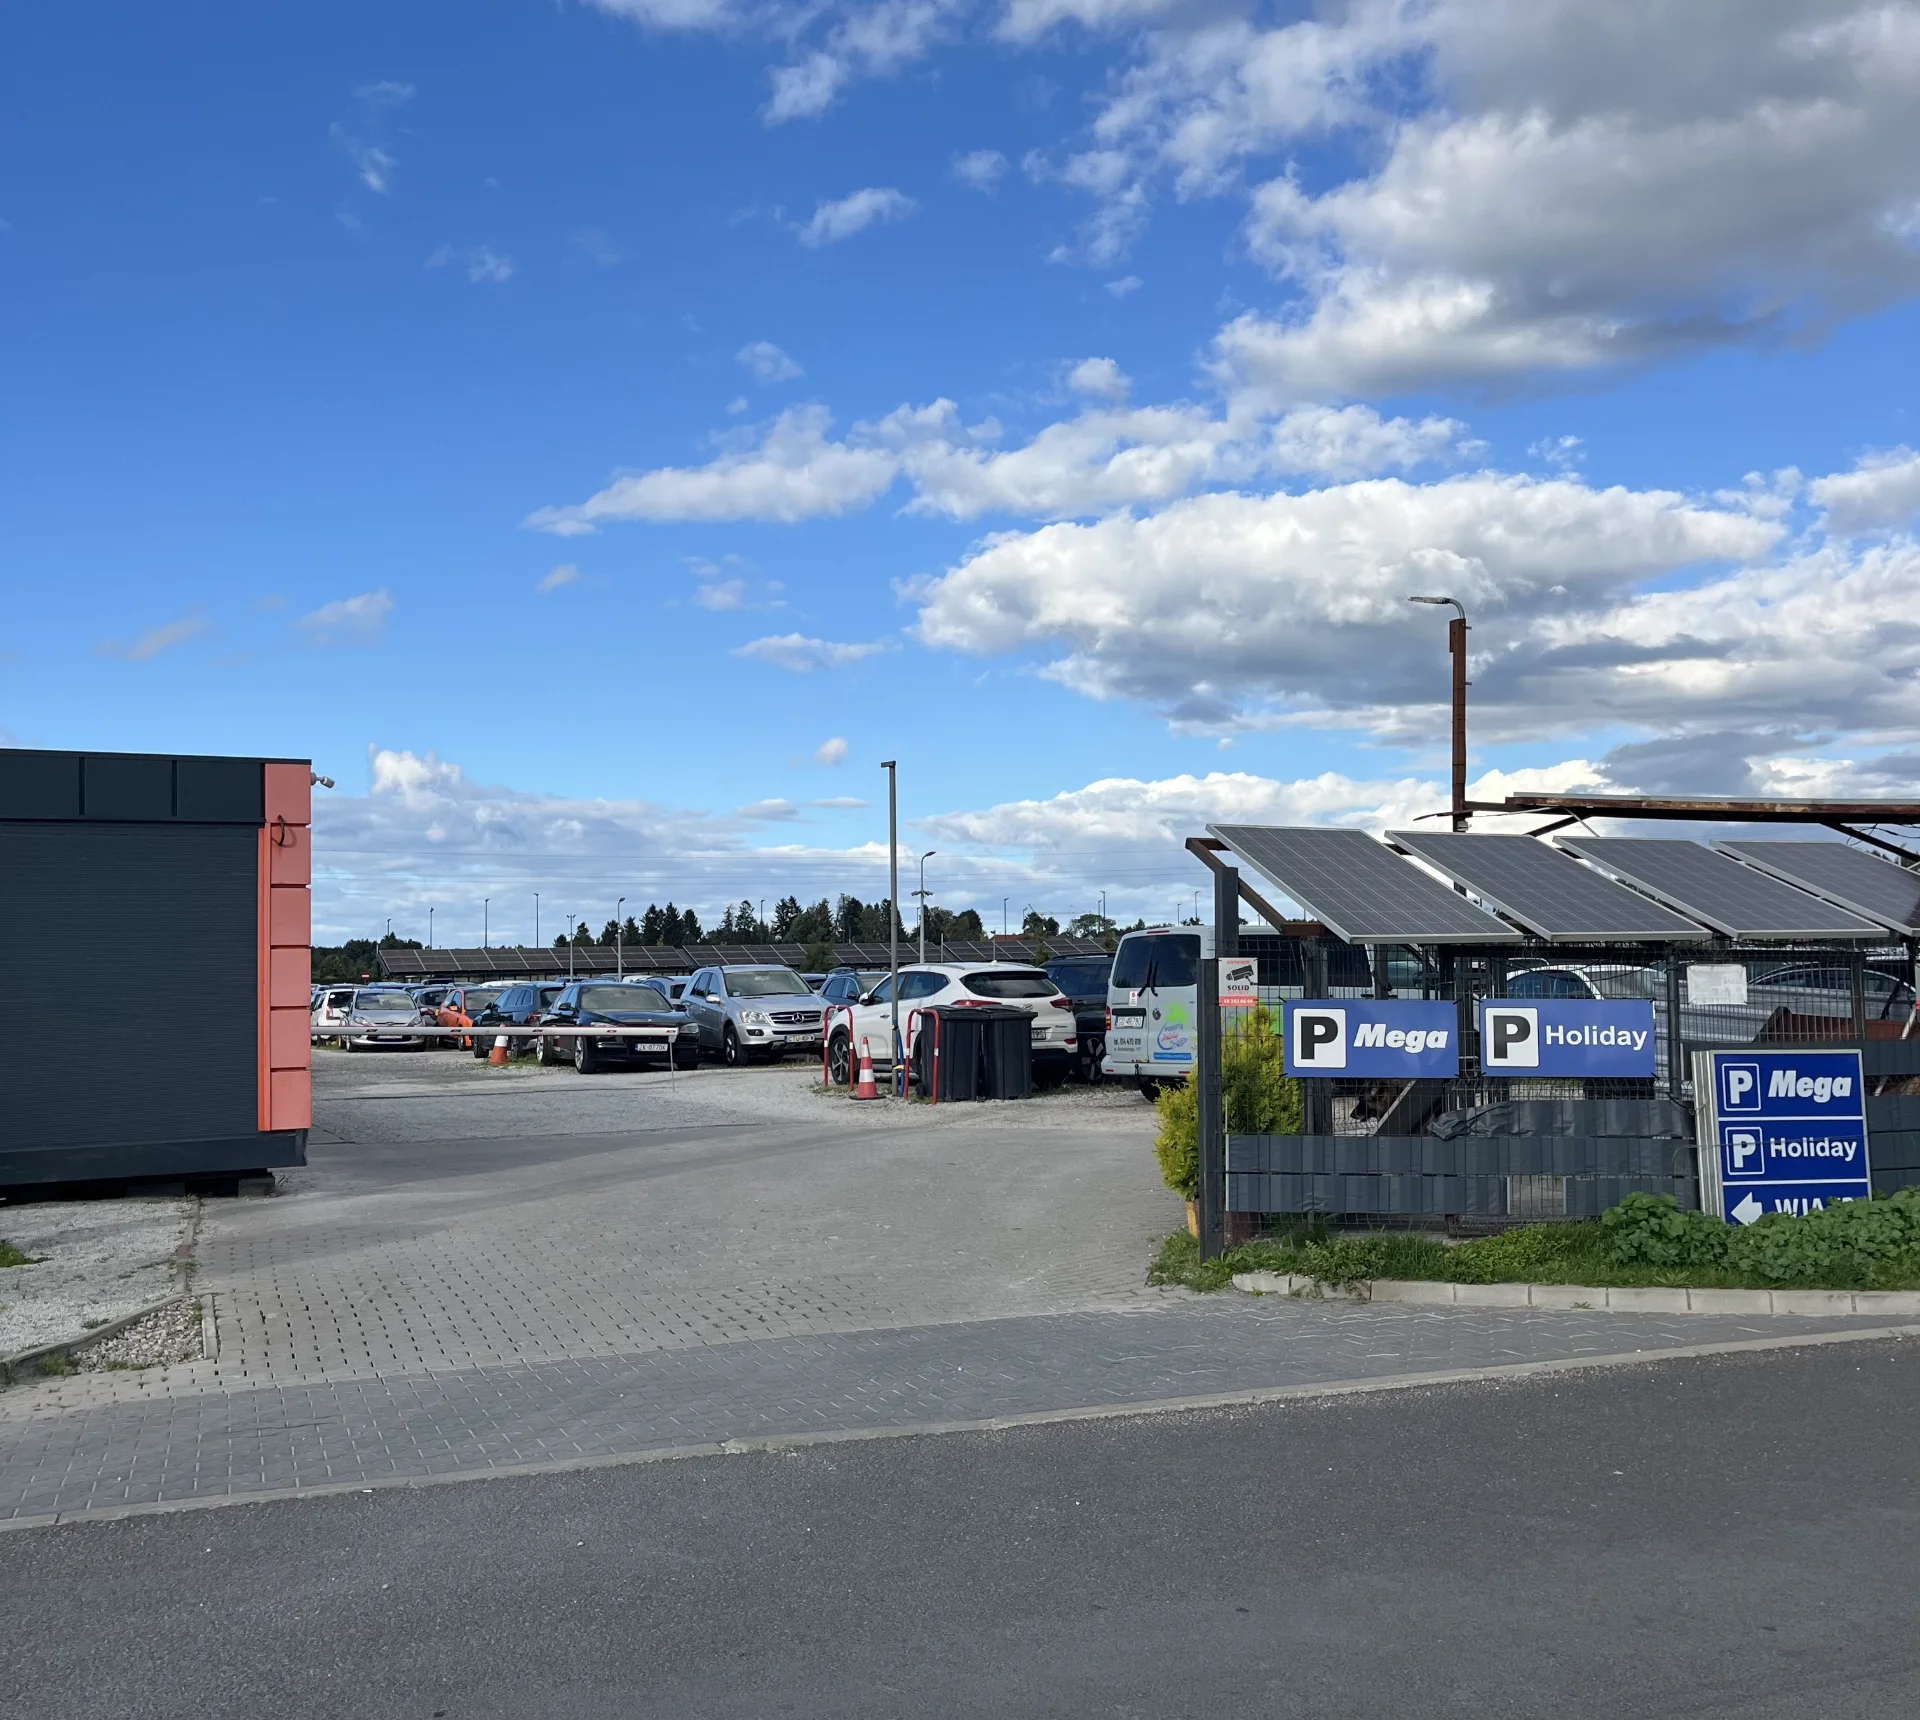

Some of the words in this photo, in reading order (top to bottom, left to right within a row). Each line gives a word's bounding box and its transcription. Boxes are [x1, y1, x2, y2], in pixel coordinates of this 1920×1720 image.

[1300, 1016, 1338, 1060] P
[1353, 1023, 1448, 1053] Mega
[1492, 1015, 1531, 1059] P
[1545, 1025, 1648, 1051] Holiday
[1729, 1070, 1753, 1104] P
[1768, 1070, 1852, 1103] Mega
[1732, 1134, 1756, 1168] P
[1769, 1137, 1857, 1162] Holiday
